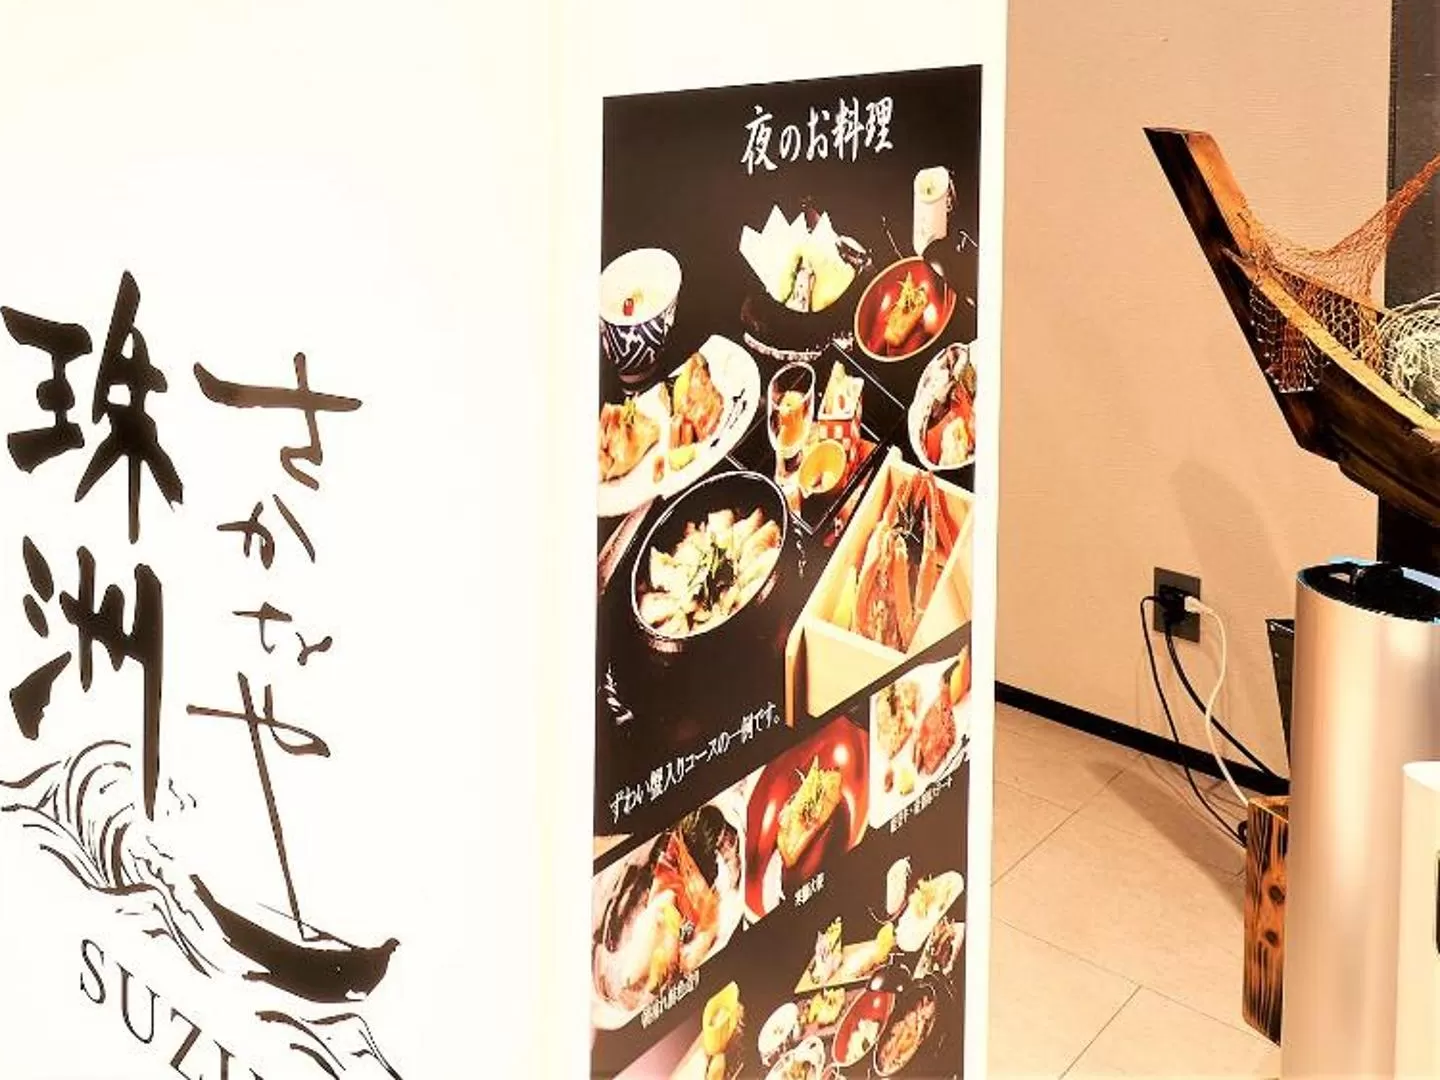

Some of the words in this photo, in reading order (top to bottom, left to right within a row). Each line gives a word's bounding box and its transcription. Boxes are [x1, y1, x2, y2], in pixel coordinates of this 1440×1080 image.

[740, 96, 894, 176] 夜のお料理
[0, 270, 184, 820] 珠洲
[185, 351, 364, 762] さかなや
